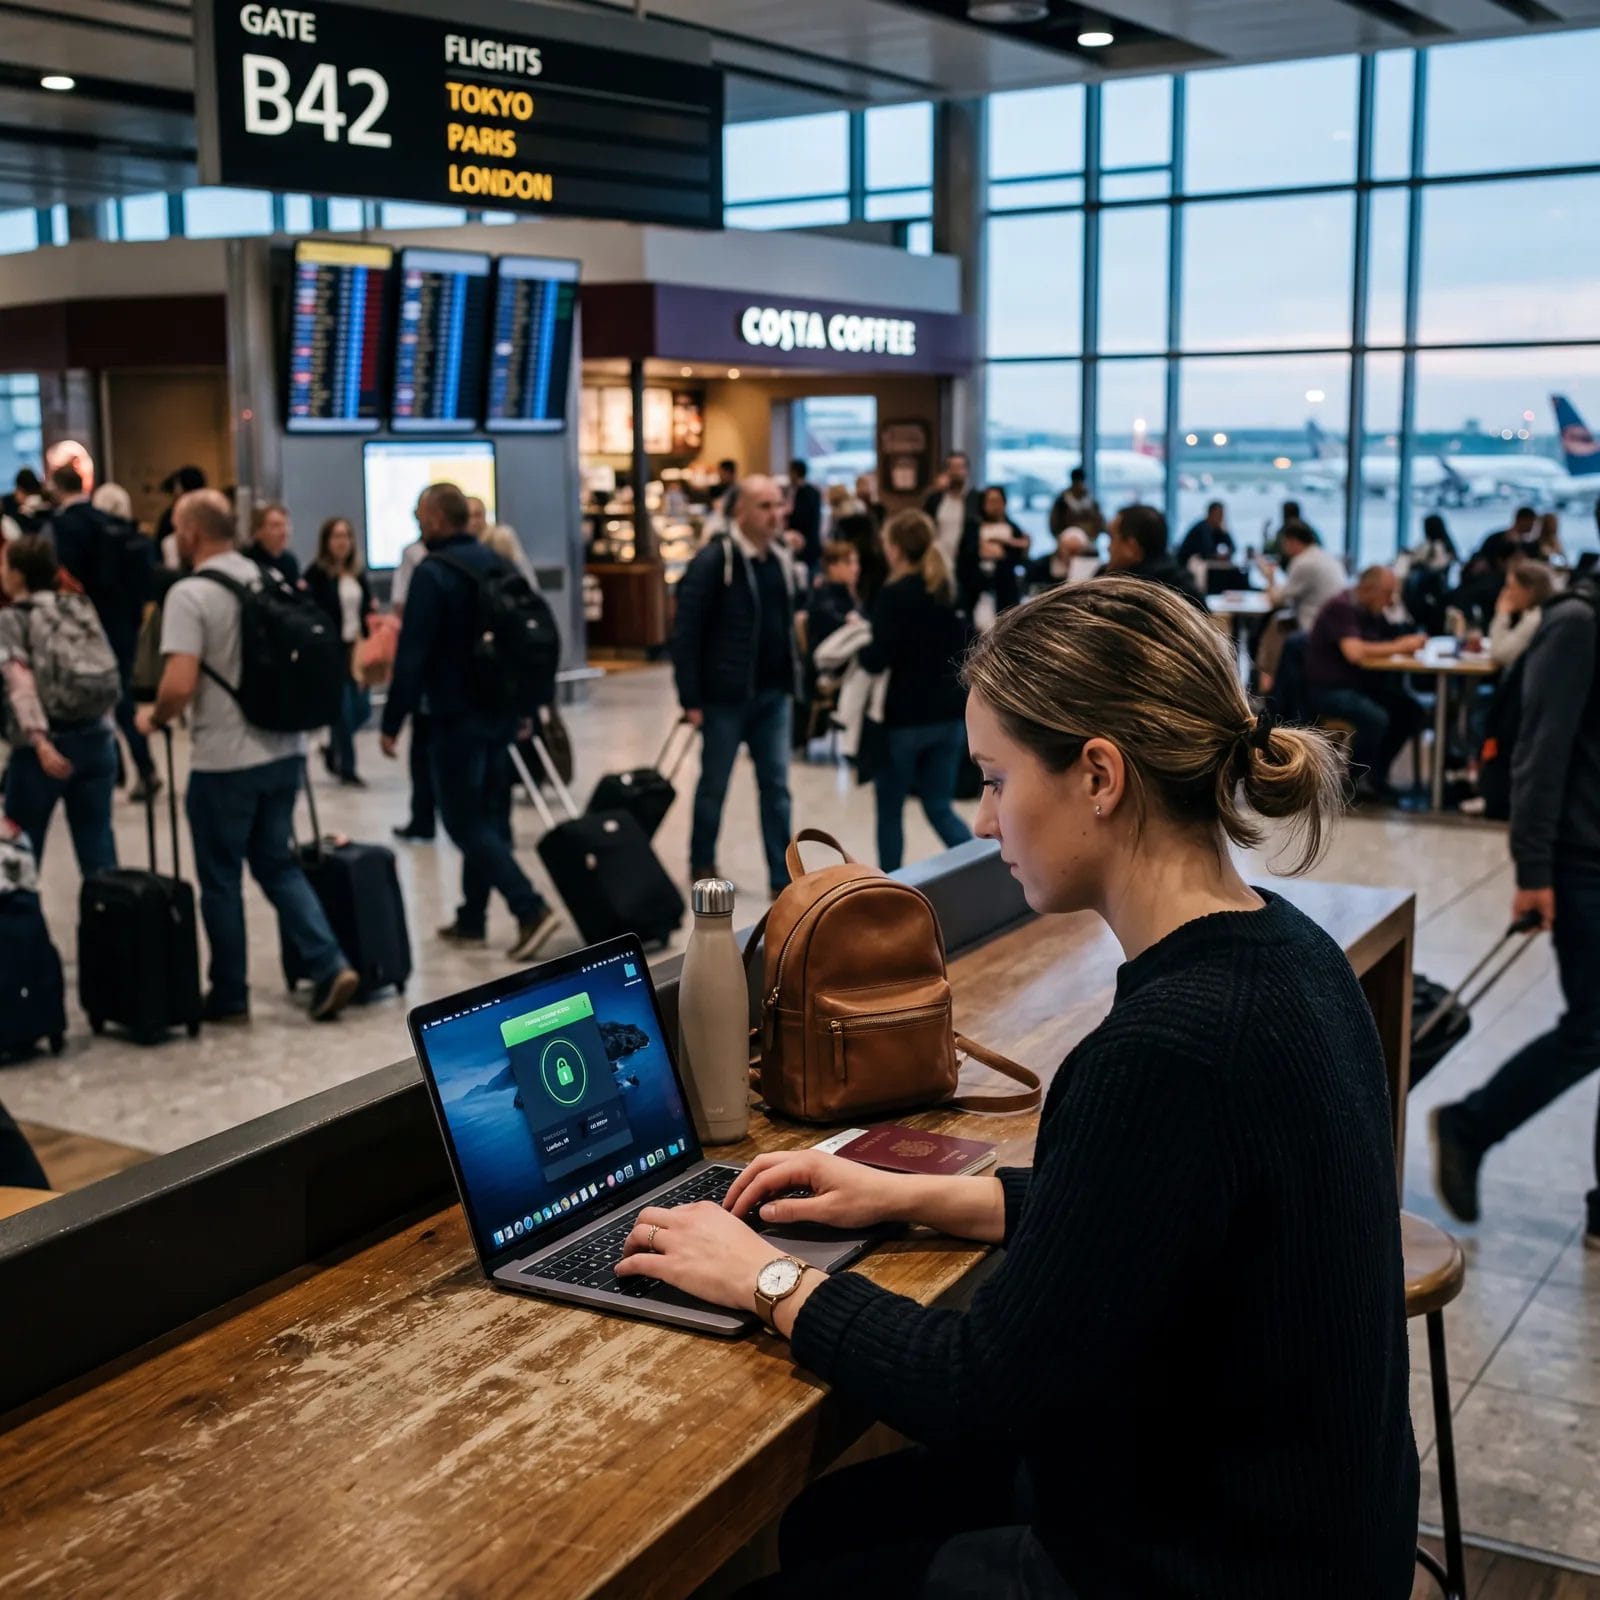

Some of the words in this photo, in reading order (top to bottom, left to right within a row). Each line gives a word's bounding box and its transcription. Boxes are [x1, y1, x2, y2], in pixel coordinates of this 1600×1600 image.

[240, 4, 316, 42] GATE
[445, 35, 542, 75] FLIGHTS
[243, 53, 392, 148] B42
[446, 82, 533, 120] TOKYO
[448, 123, 516, 159] PARIS
[449, 165, 552, 202] LONDON
[742, 306, 827, 351] COSTA
[828, 314, 916, 356] COFFEE
